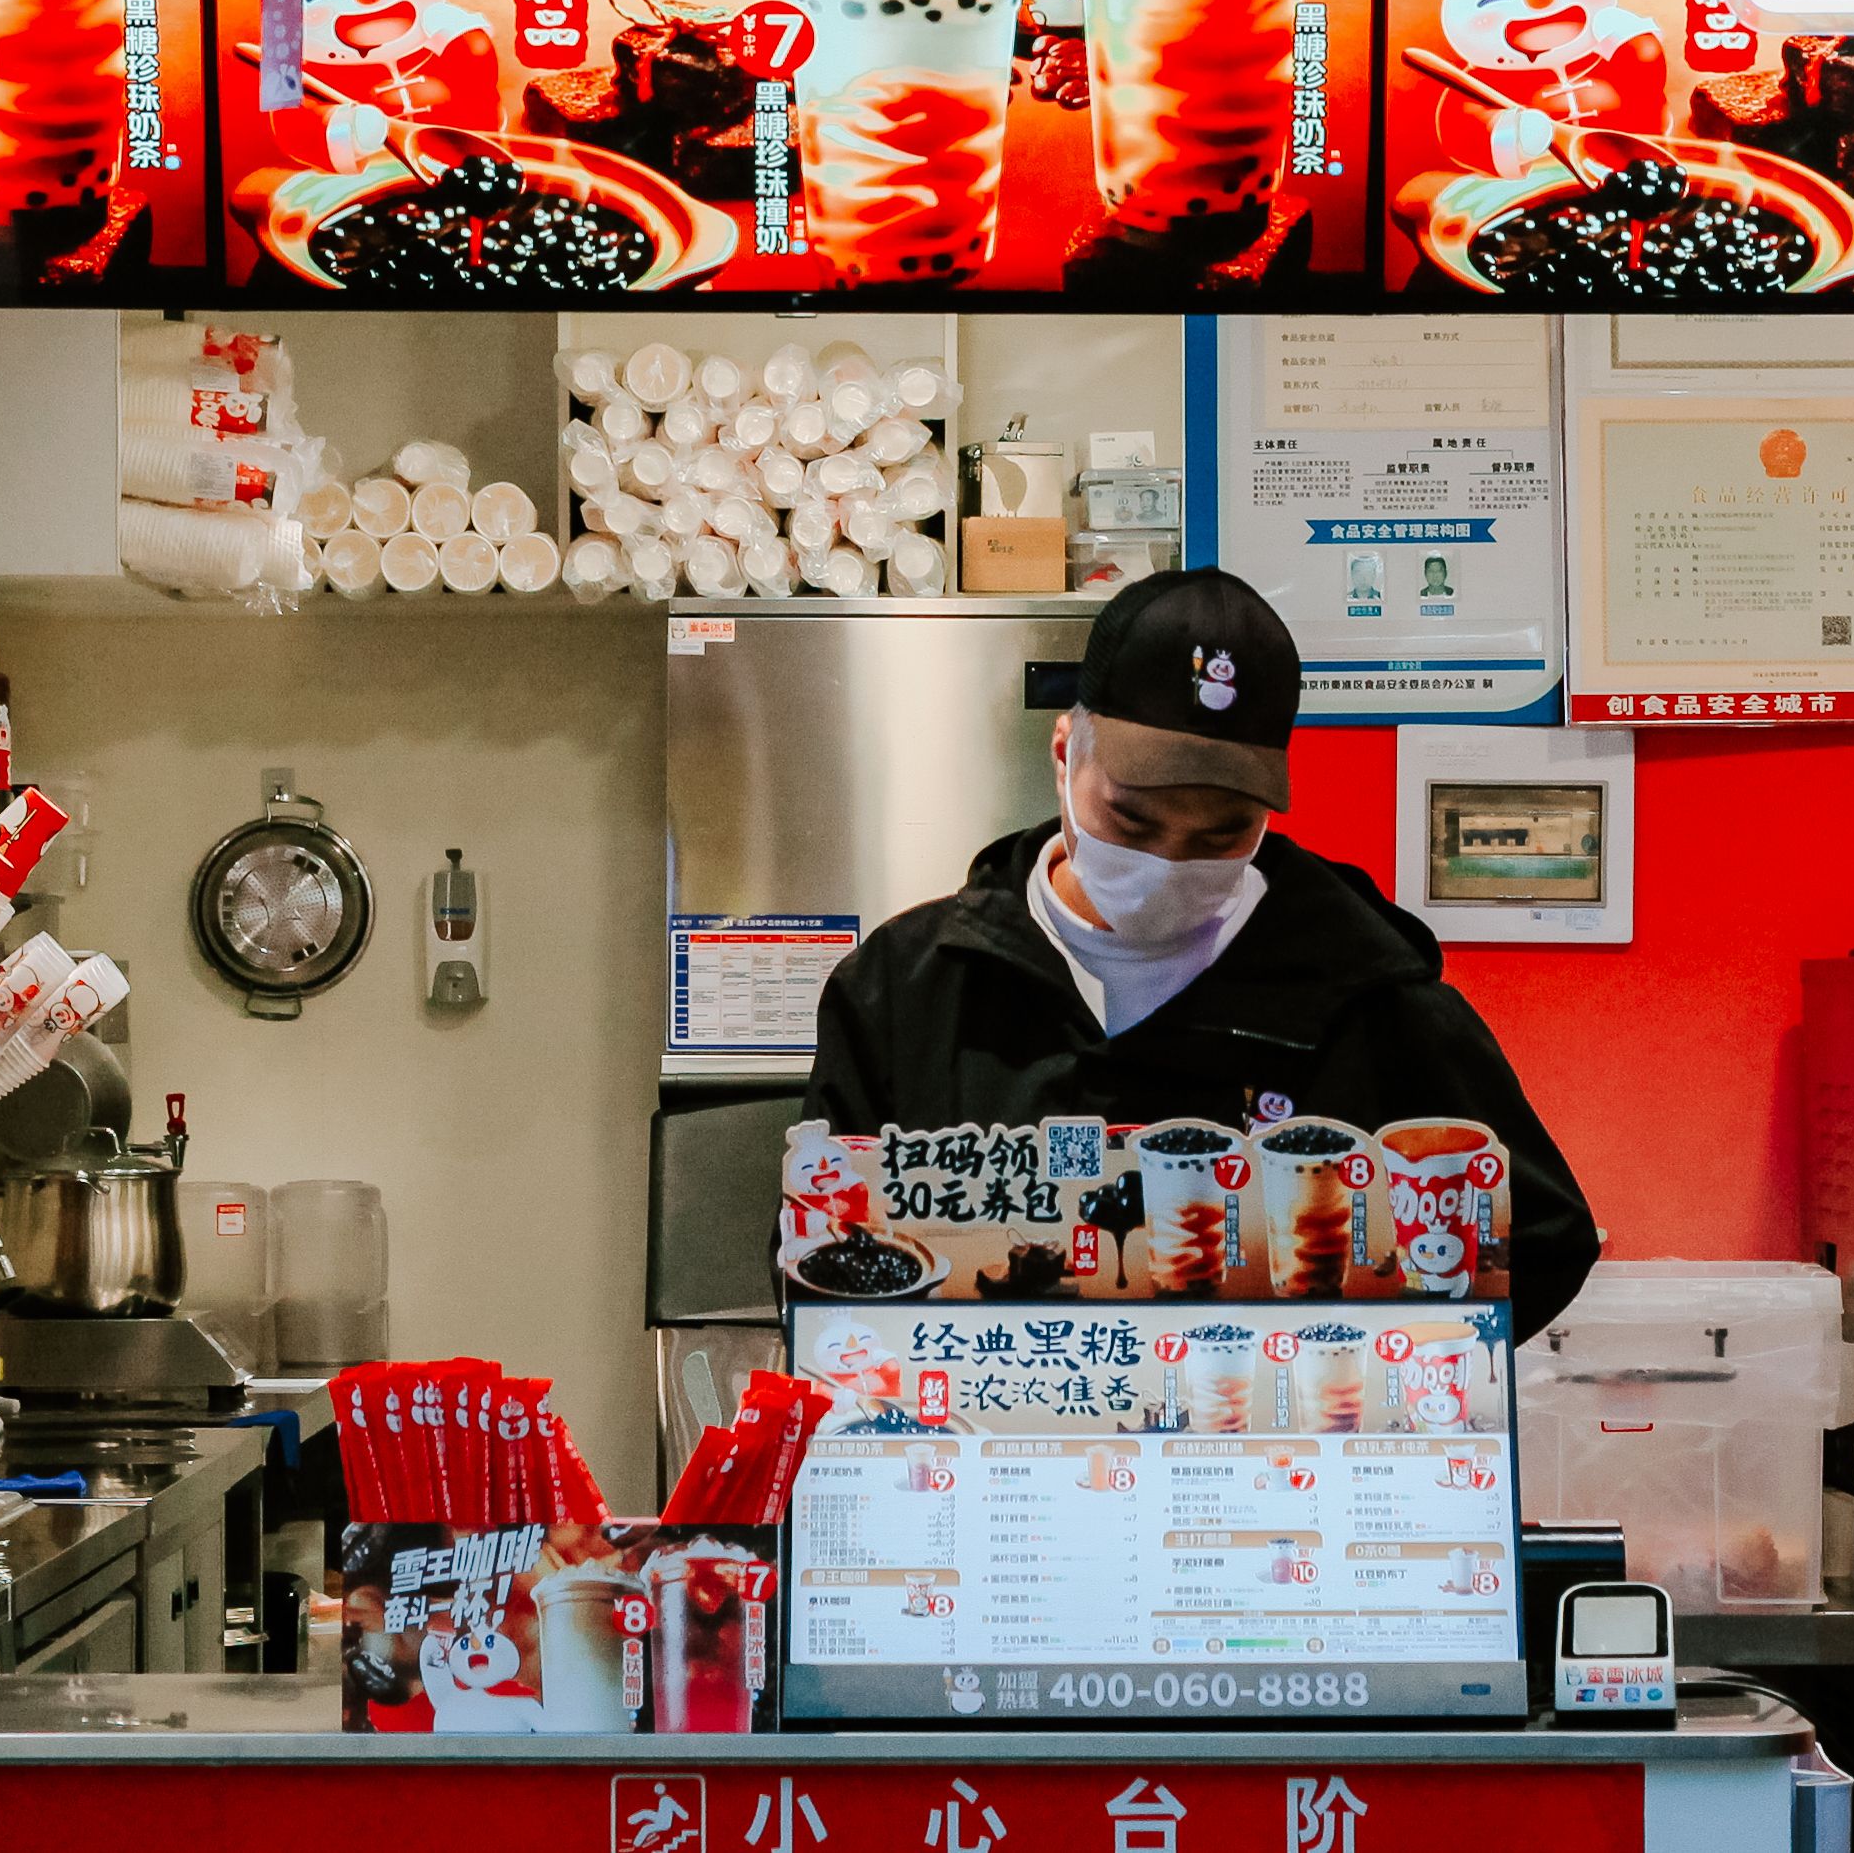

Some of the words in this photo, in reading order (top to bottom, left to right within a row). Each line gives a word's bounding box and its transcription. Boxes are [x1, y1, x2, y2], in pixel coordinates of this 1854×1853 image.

[1292, 2, 1329, 176] 黑糖珍珠奶茶
[753, 81, 790, 256] 黑糖珍珠撞奶
[1253, 440, 1299, 451] 主体责任
[1432, 438, 1488, 449] 属地责任
[1386, 463, 1431, 474] 监管职责
[1491, 462, 1536, 473] 督导职责
[1330, 523, 1472, 540] 食品安全管理架构图
[1607, 693, 1837, 716] 创食品安全城市
[880, 1131, 1039, 1179] 扫码领
[884, 1180, 1062, 1223] 30元券包
[1075, 1229, 1096, 1273] 新品
[910, 1319, 1147, 1369] 经典黑糖
[923, 1376, 945, 1420] 新品
[958, 1374, 1140, 1416] 浓浓焦香
[391, 1523, 545, 1595] 雪王咖啡
[623, 1640, 643, 1709] 拿铁咖啡
[996, 1670, 1040, 1691] 加盟
[1049, 1670, 1371, 1709] 400-060-8888
[1587, 1666, 1665, 1685] 蜜雪冰城
[996, 1692, 1040, 1712] 热线
[744, 1775, 1370, 1853] 小心台阶
